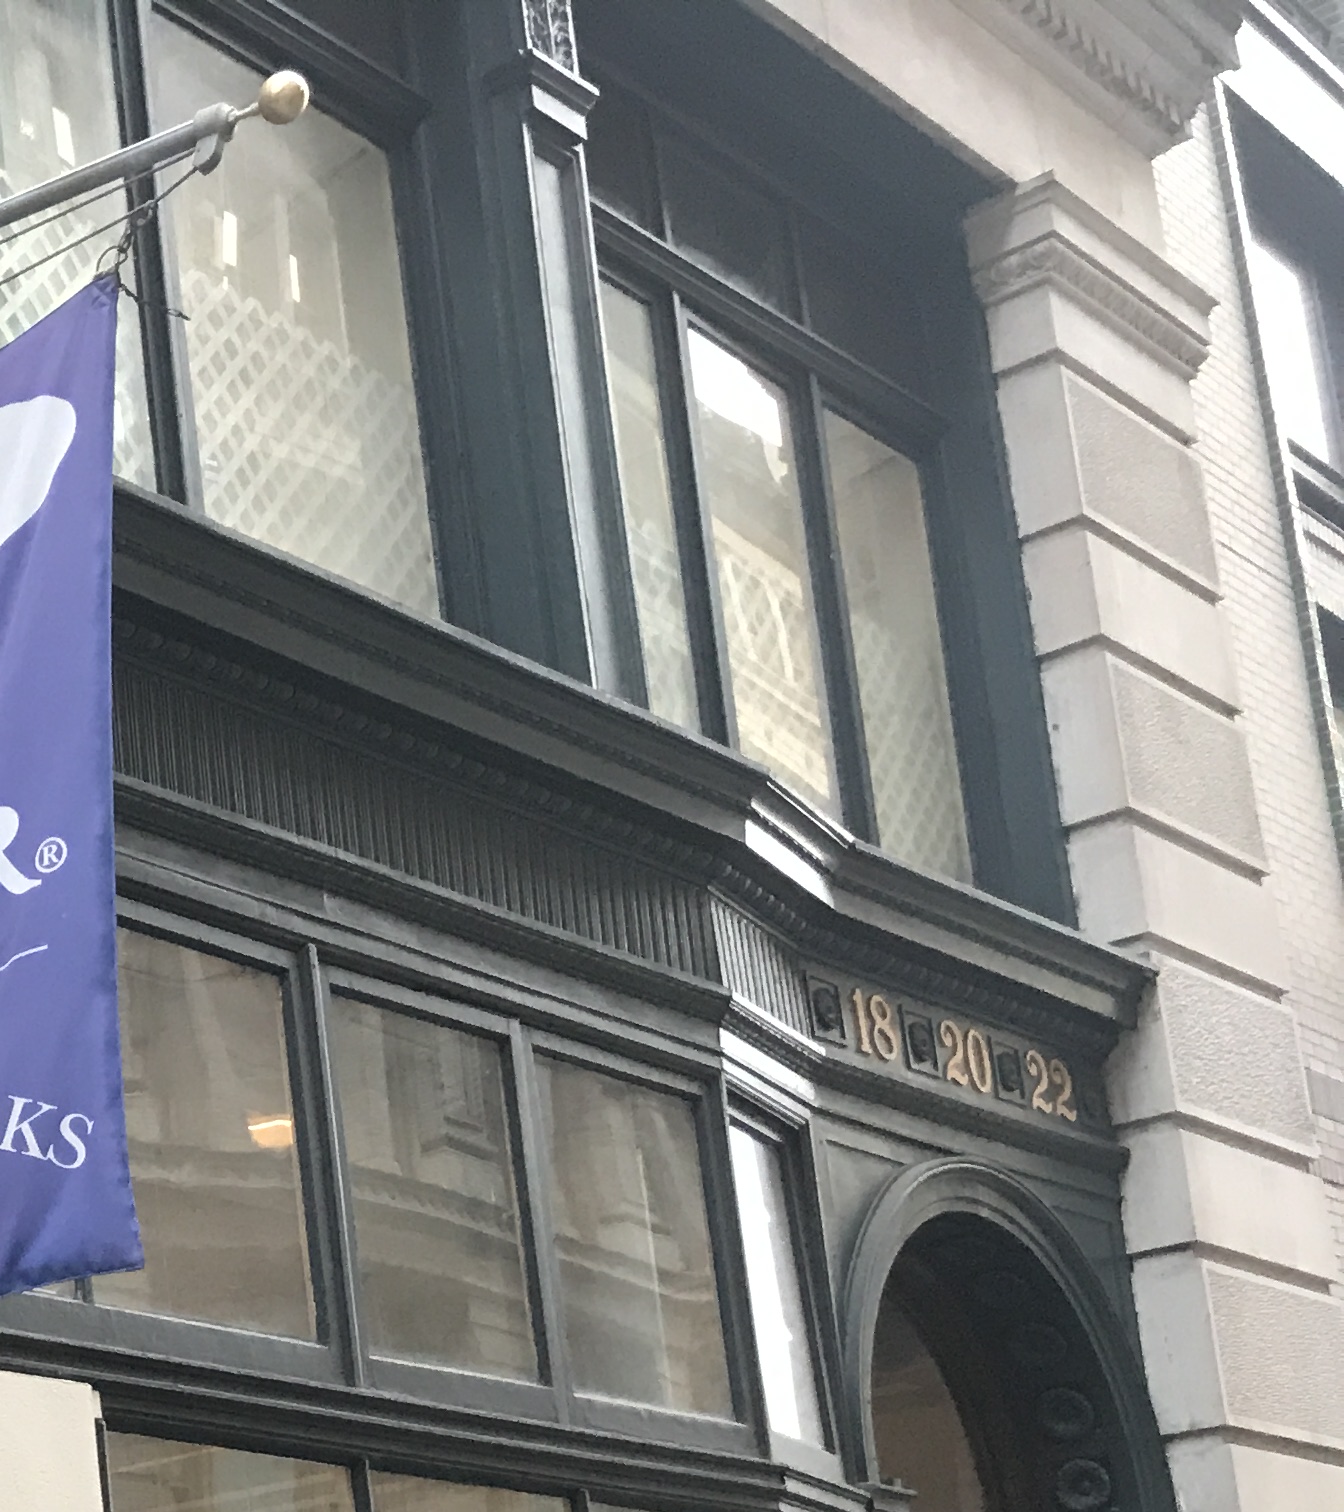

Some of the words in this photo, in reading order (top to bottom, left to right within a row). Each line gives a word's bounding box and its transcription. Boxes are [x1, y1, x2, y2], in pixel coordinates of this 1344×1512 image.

[852, 988, 898, 1061] 18
[940, 1019, 992, 1093] 20
[1026, 1049, 1078, 1121] 22
